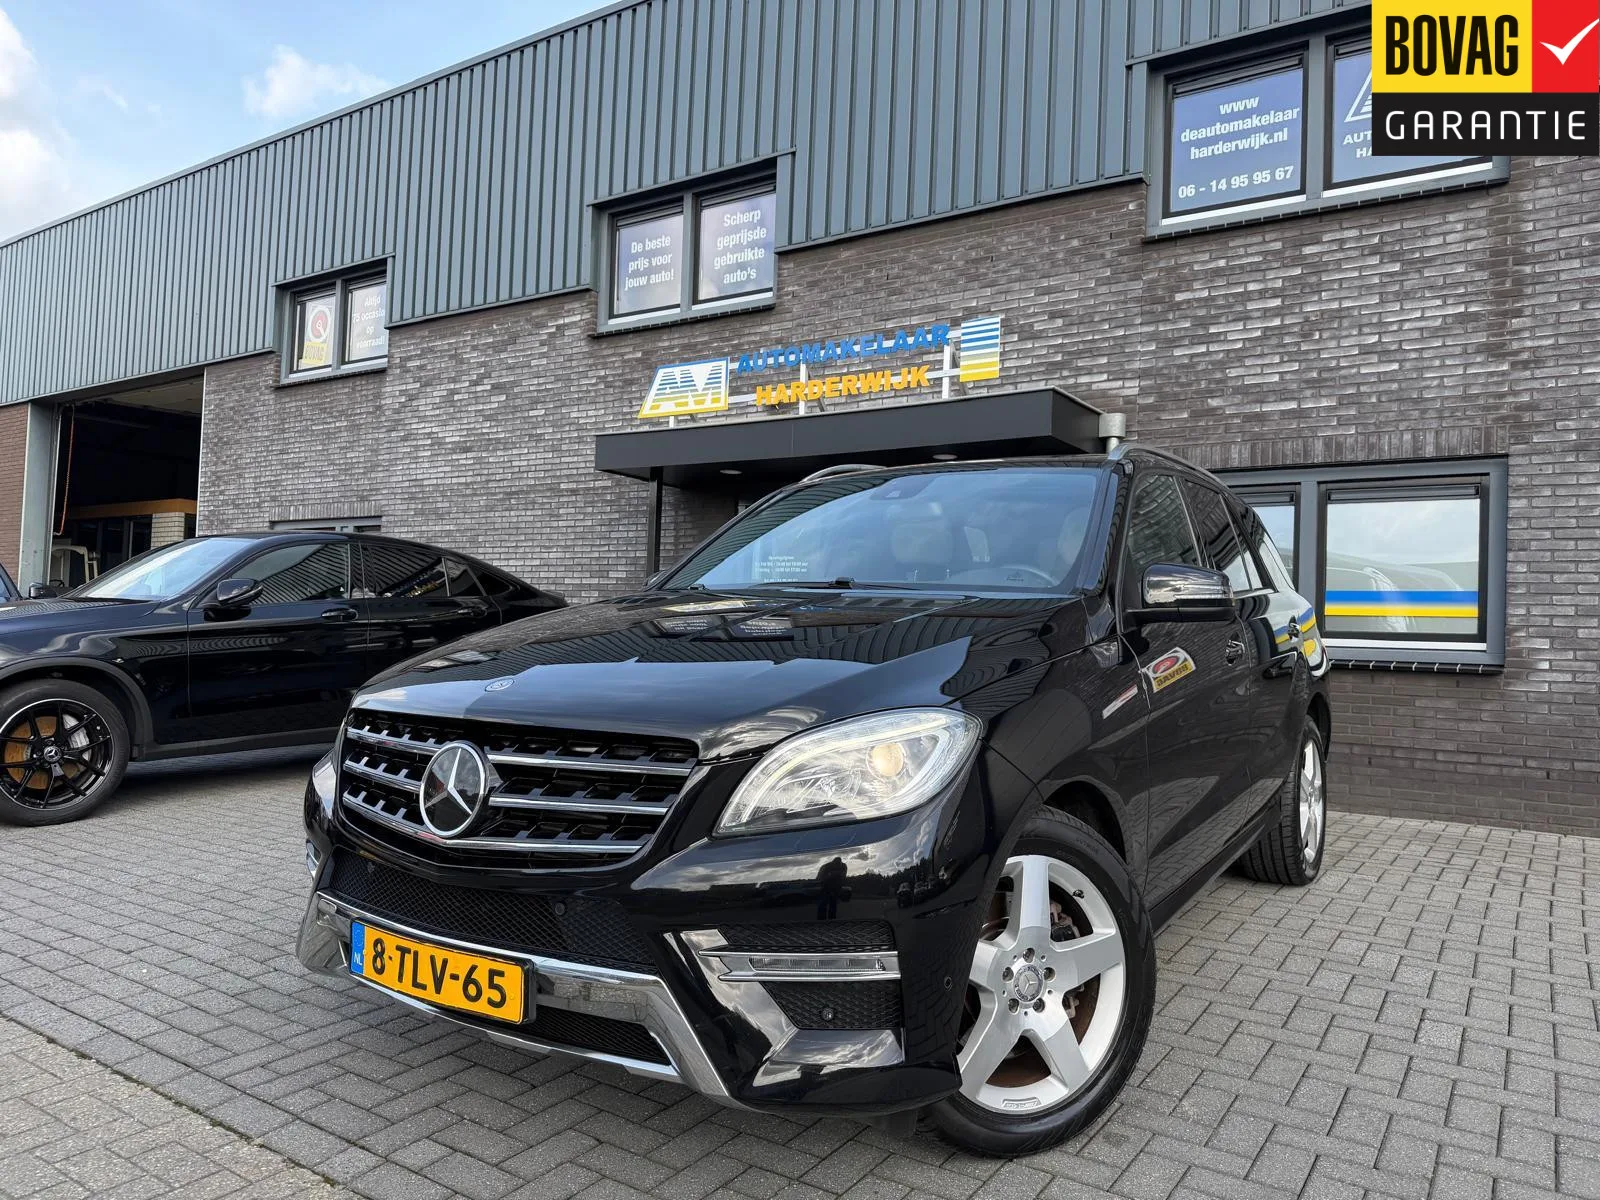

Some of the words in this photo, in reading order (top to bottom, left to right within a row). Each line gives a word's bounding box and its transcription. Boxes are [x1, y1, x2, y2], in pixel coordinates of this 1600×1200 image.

[1219, 96, 1260, 115] www
[1180, 108, 1301, 143] deautomakelaar
[1190, 128, 1289, 160] harderwijk.nl
[1178, 184, 1196, 199] 06
[1209, 179, 1228, 193] 14
[1230, 175, 1249, 190] 95
[1252, 171, 1271, 186] 95
[1274, 165, 1294, 182] 67
[723, 209, 761, 227] Scherp
[631, 241, 643, 253] De
[645, 236, 671, 250] beste
[717, 227, 767, 250] geprijsde
[628, 256, 649, 273] prijs
[651, 253, 673, 267] voor
[713, 247, 765, 269] gebruikte
[624, 273, 647, 291] jouw
[650, 268, 674, 284] auto!
[723, 268, 757, 284] auto's
[736, 323, 951, 375] AUTOMAKELAAR
[755, 365, 931, 407] HARDERWIJK
[353, 951, 363, 966] NL
[372, 937, 507, 1009] 8-TLV-65
